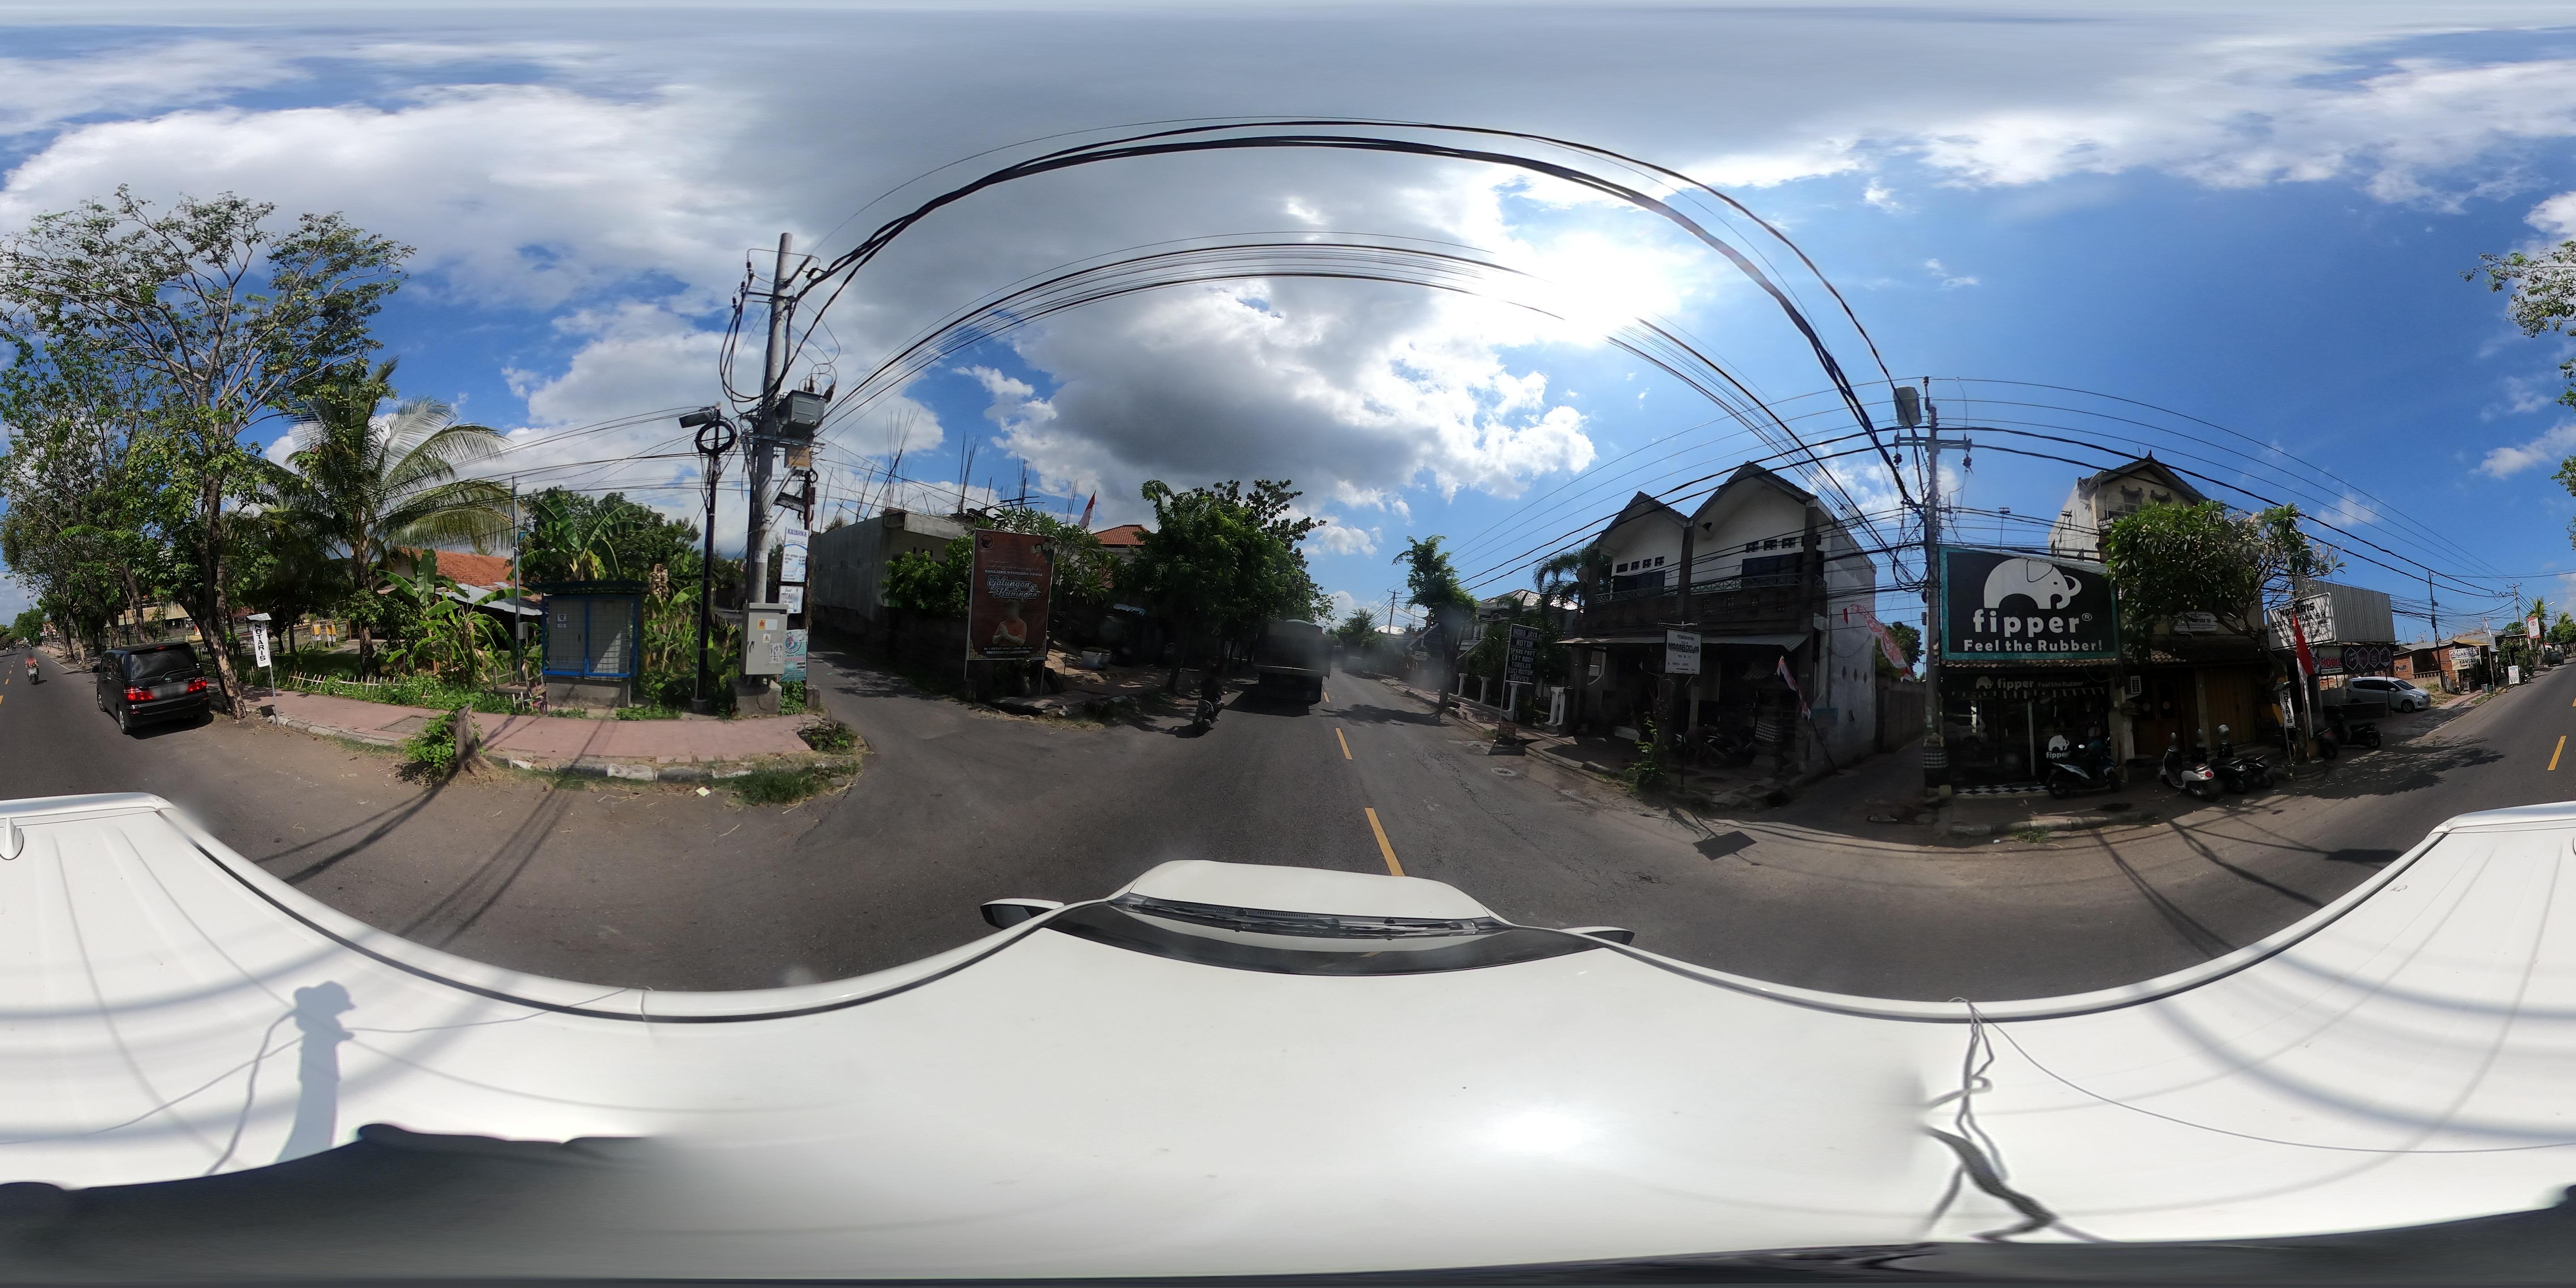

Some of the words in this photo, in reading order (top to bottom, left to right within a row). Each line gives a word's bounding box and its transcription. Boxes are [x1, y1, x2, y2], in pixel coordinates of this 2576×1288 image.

[787, 529, 807, 537] KRISHNA
[988, 576, 1030, 590] Galungan
[993, 588, 1041, 602] Kuningan
[2279, 602, 2315, 618] NOTARIS
[1973, 609, 2080, 638] fipper
[1513, 628, 1526, 637] INDRA
[254, 623, 266, 661] NOTARIS
[1517, 639, 1534, 648] MOTOR
[1964, 640, 1999, 651] Feel
[2005, 640, 2032, 651] the
[2038, 640, 2103, 651] Rubber!
[2320, 657, 2342, 669] MOBIL
[1996, 678, 2034, 690] fipper
[2282, 691, 2292, 723] NOTARIS
